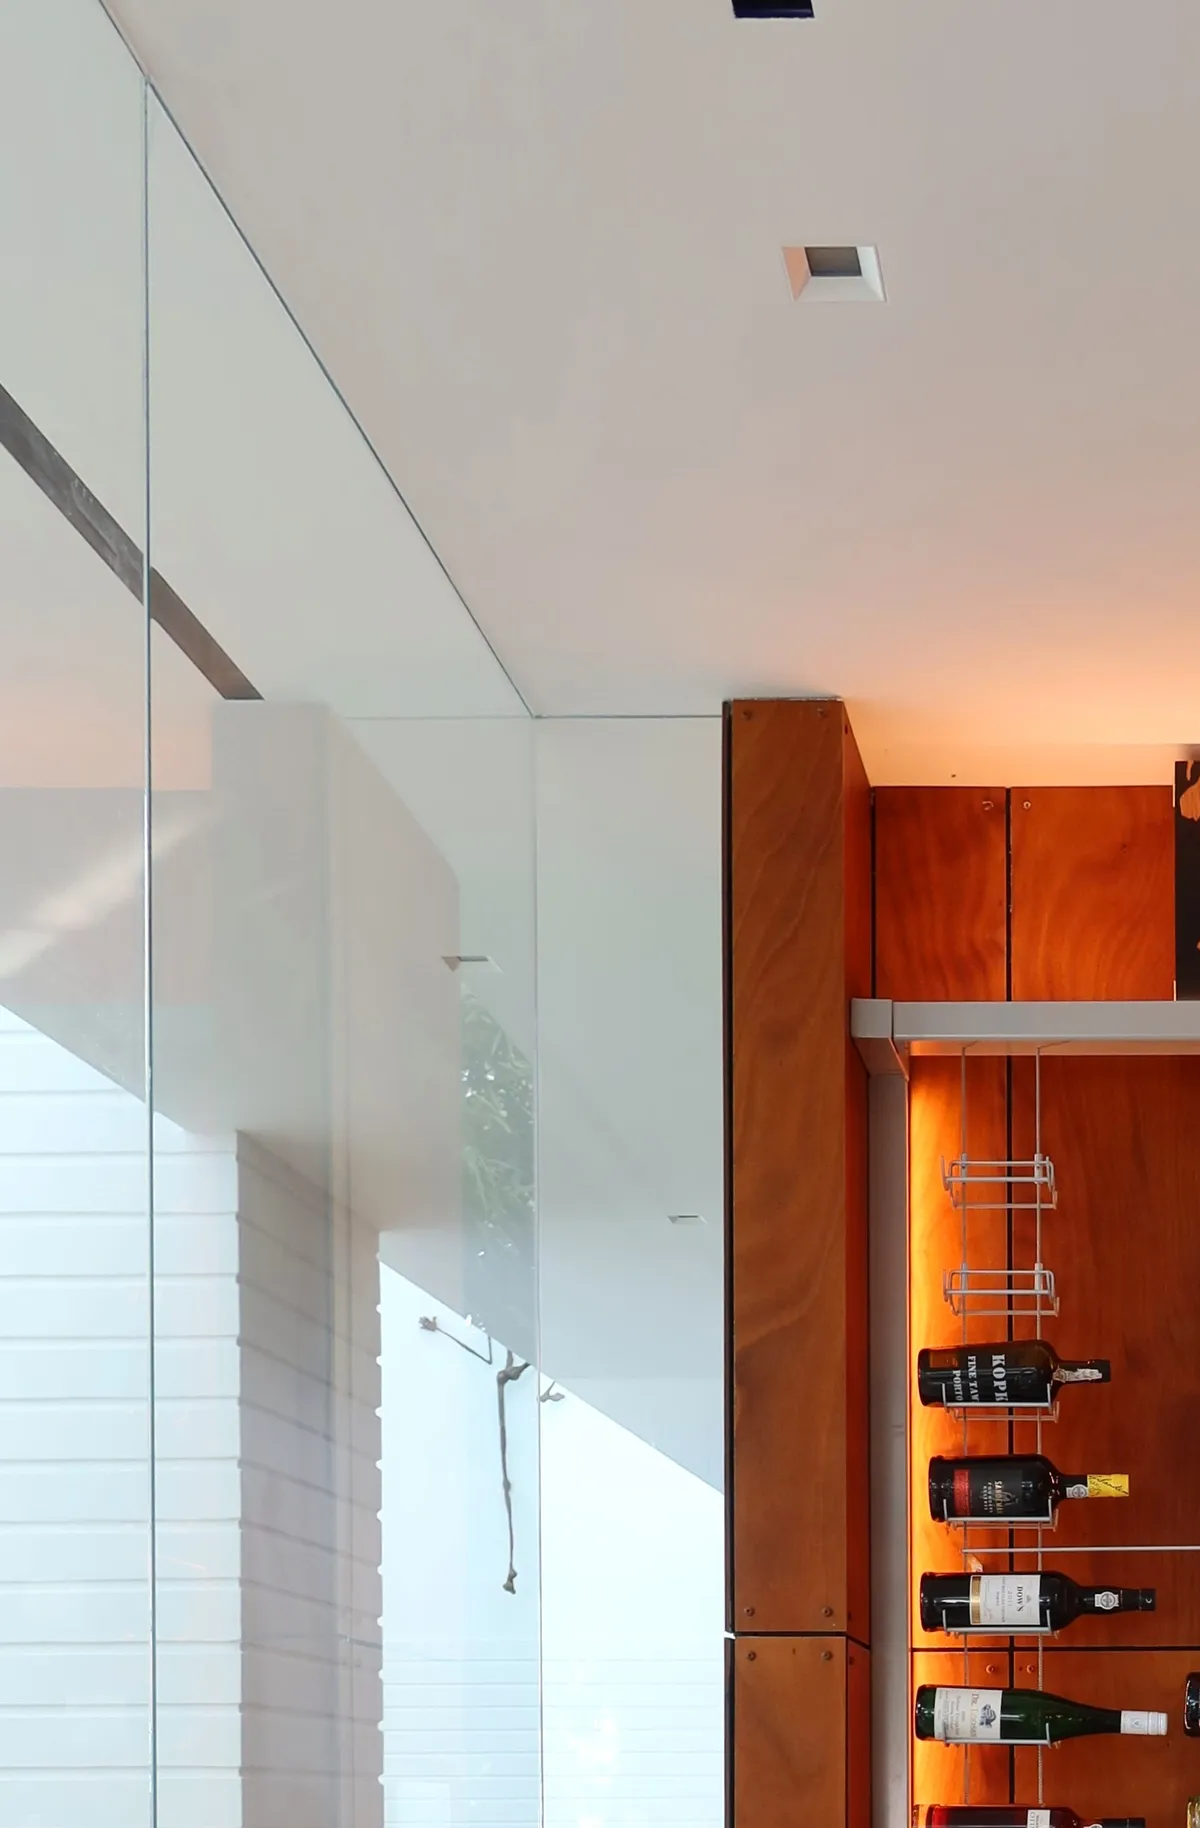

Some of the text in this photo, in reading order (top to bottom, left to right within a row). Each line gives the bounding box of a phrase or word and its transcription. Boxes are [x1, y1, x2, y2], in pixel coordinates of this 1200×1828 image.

[952, 1370, 964, 1402] PORTO
[967, 1355, 981, 1403] FINE TAW
[991, 1354, 1009, 1402] KOPK
